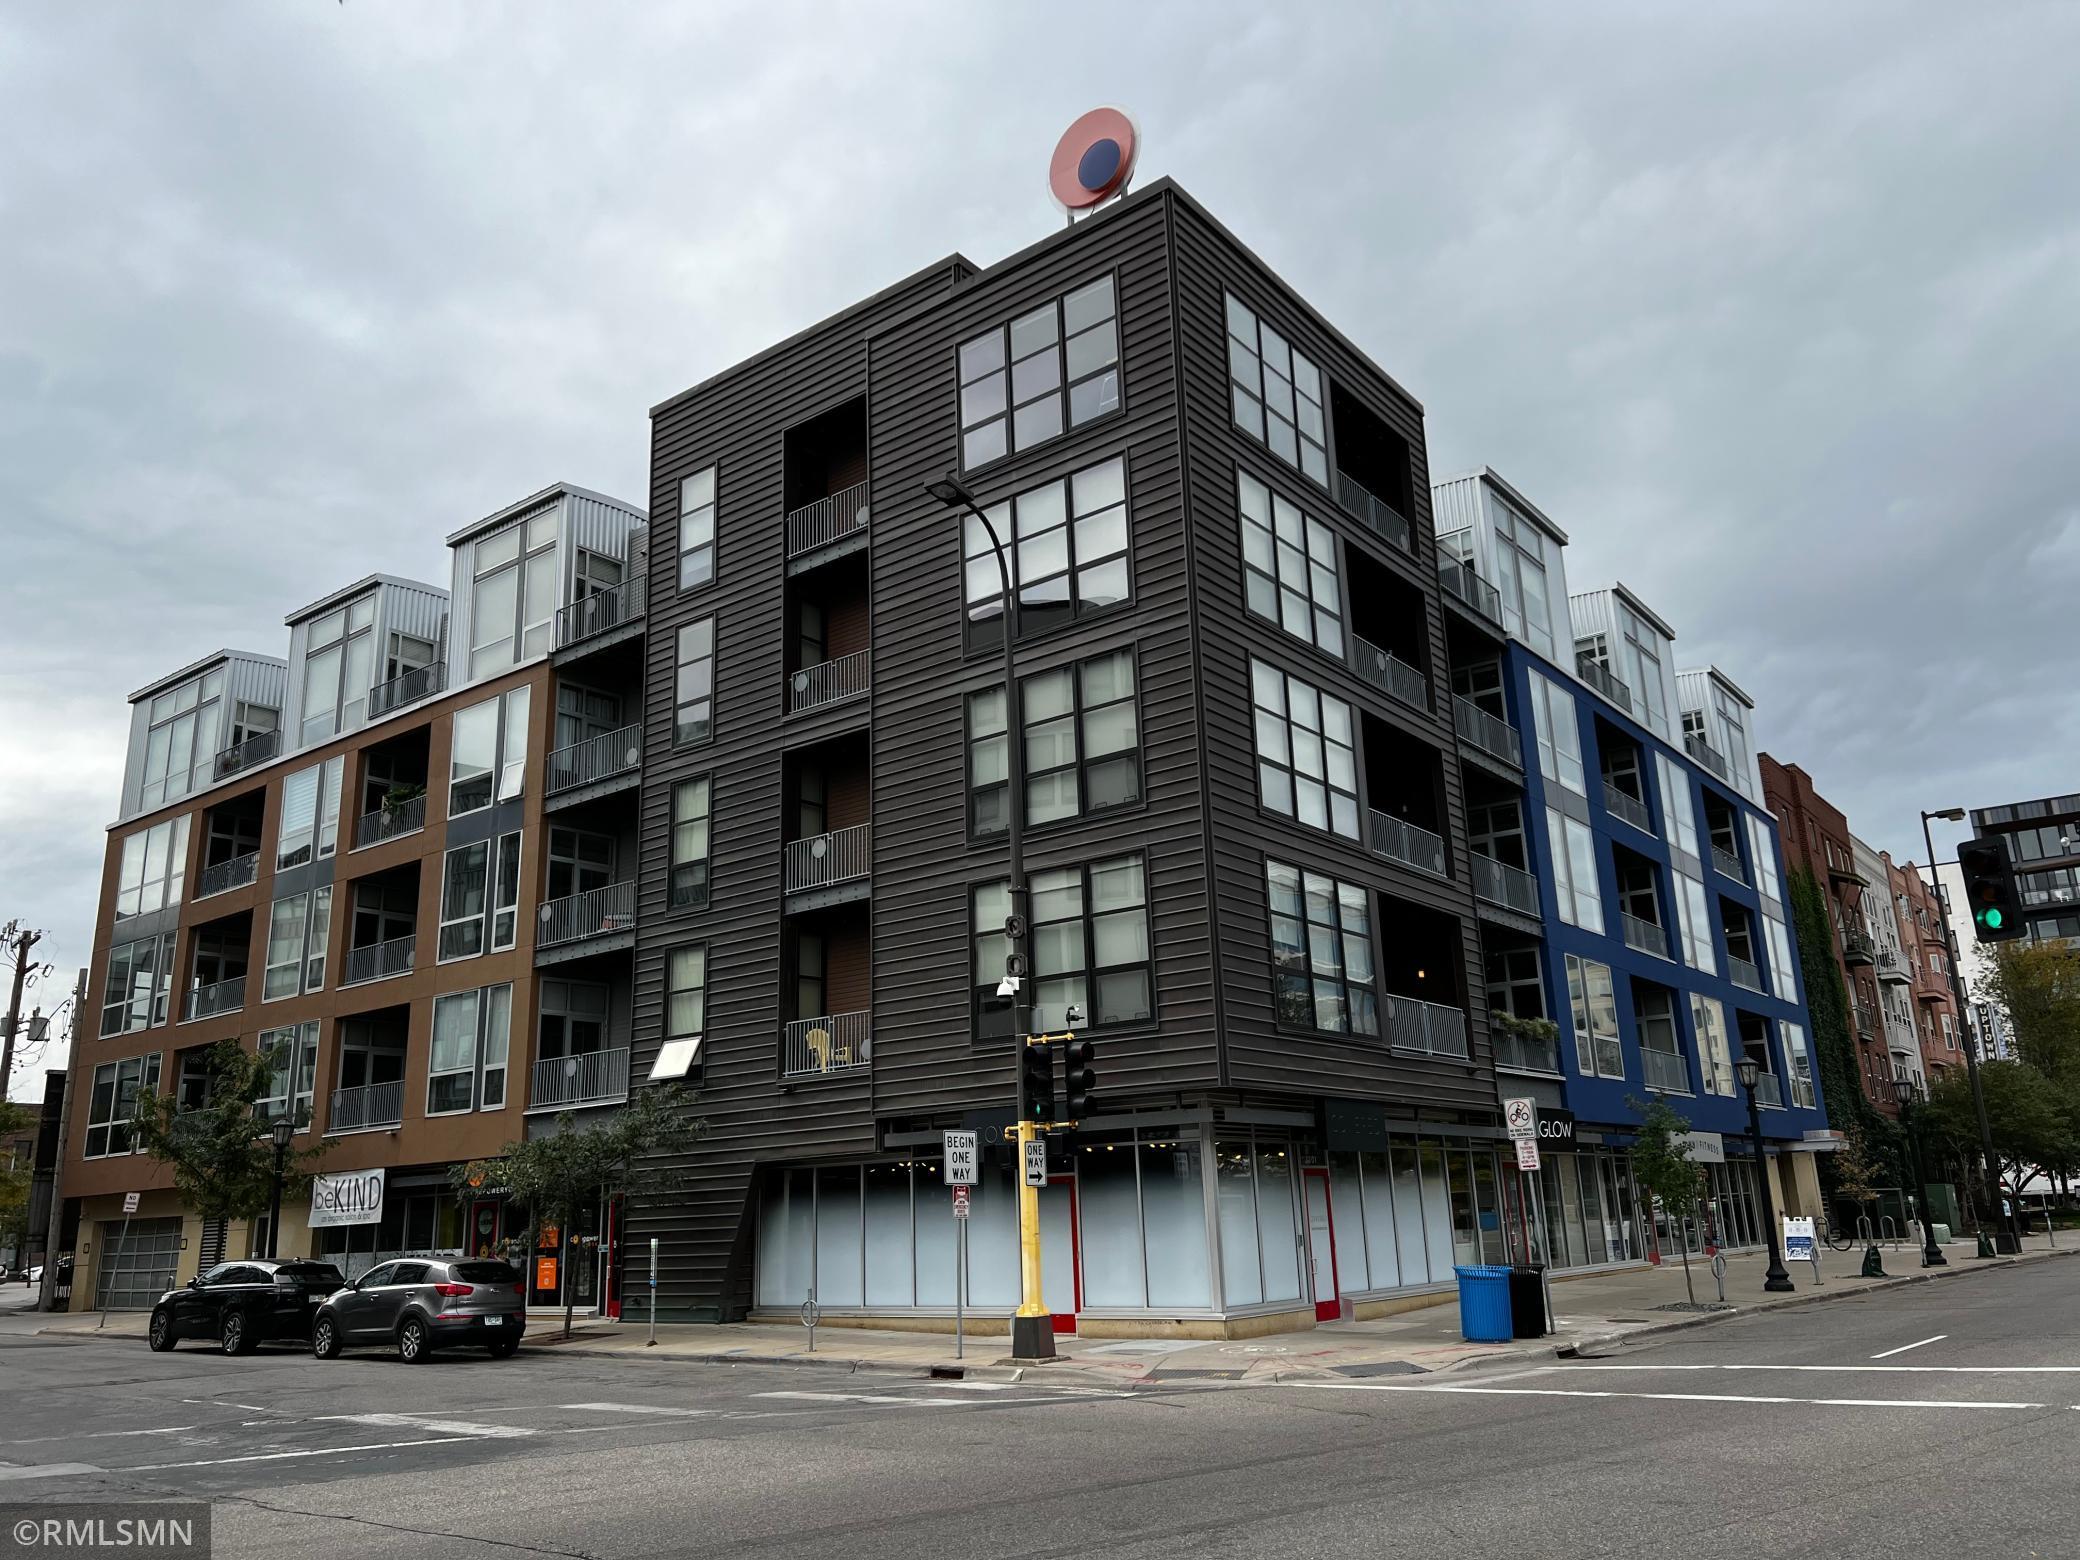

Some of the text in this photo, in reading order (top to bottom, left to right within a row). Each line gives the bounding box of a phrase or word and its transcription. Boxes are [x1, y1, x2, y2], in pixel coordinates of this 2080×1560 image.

[1980, 1007, 1995, 1060] UPTOWN
[1539, 1120, 1572, 1138] GLOW
[947, 1136, 974, 1149] BEGIN
[1027, 1145, 1043, 1155] ONE
[952, 1151, 970, 1163] ONE
[1027, 1158, 1044, 1168] WAY
[952, 1168, 971, 1180] WAY
[315, 1176, 381, 1213] beKIND
